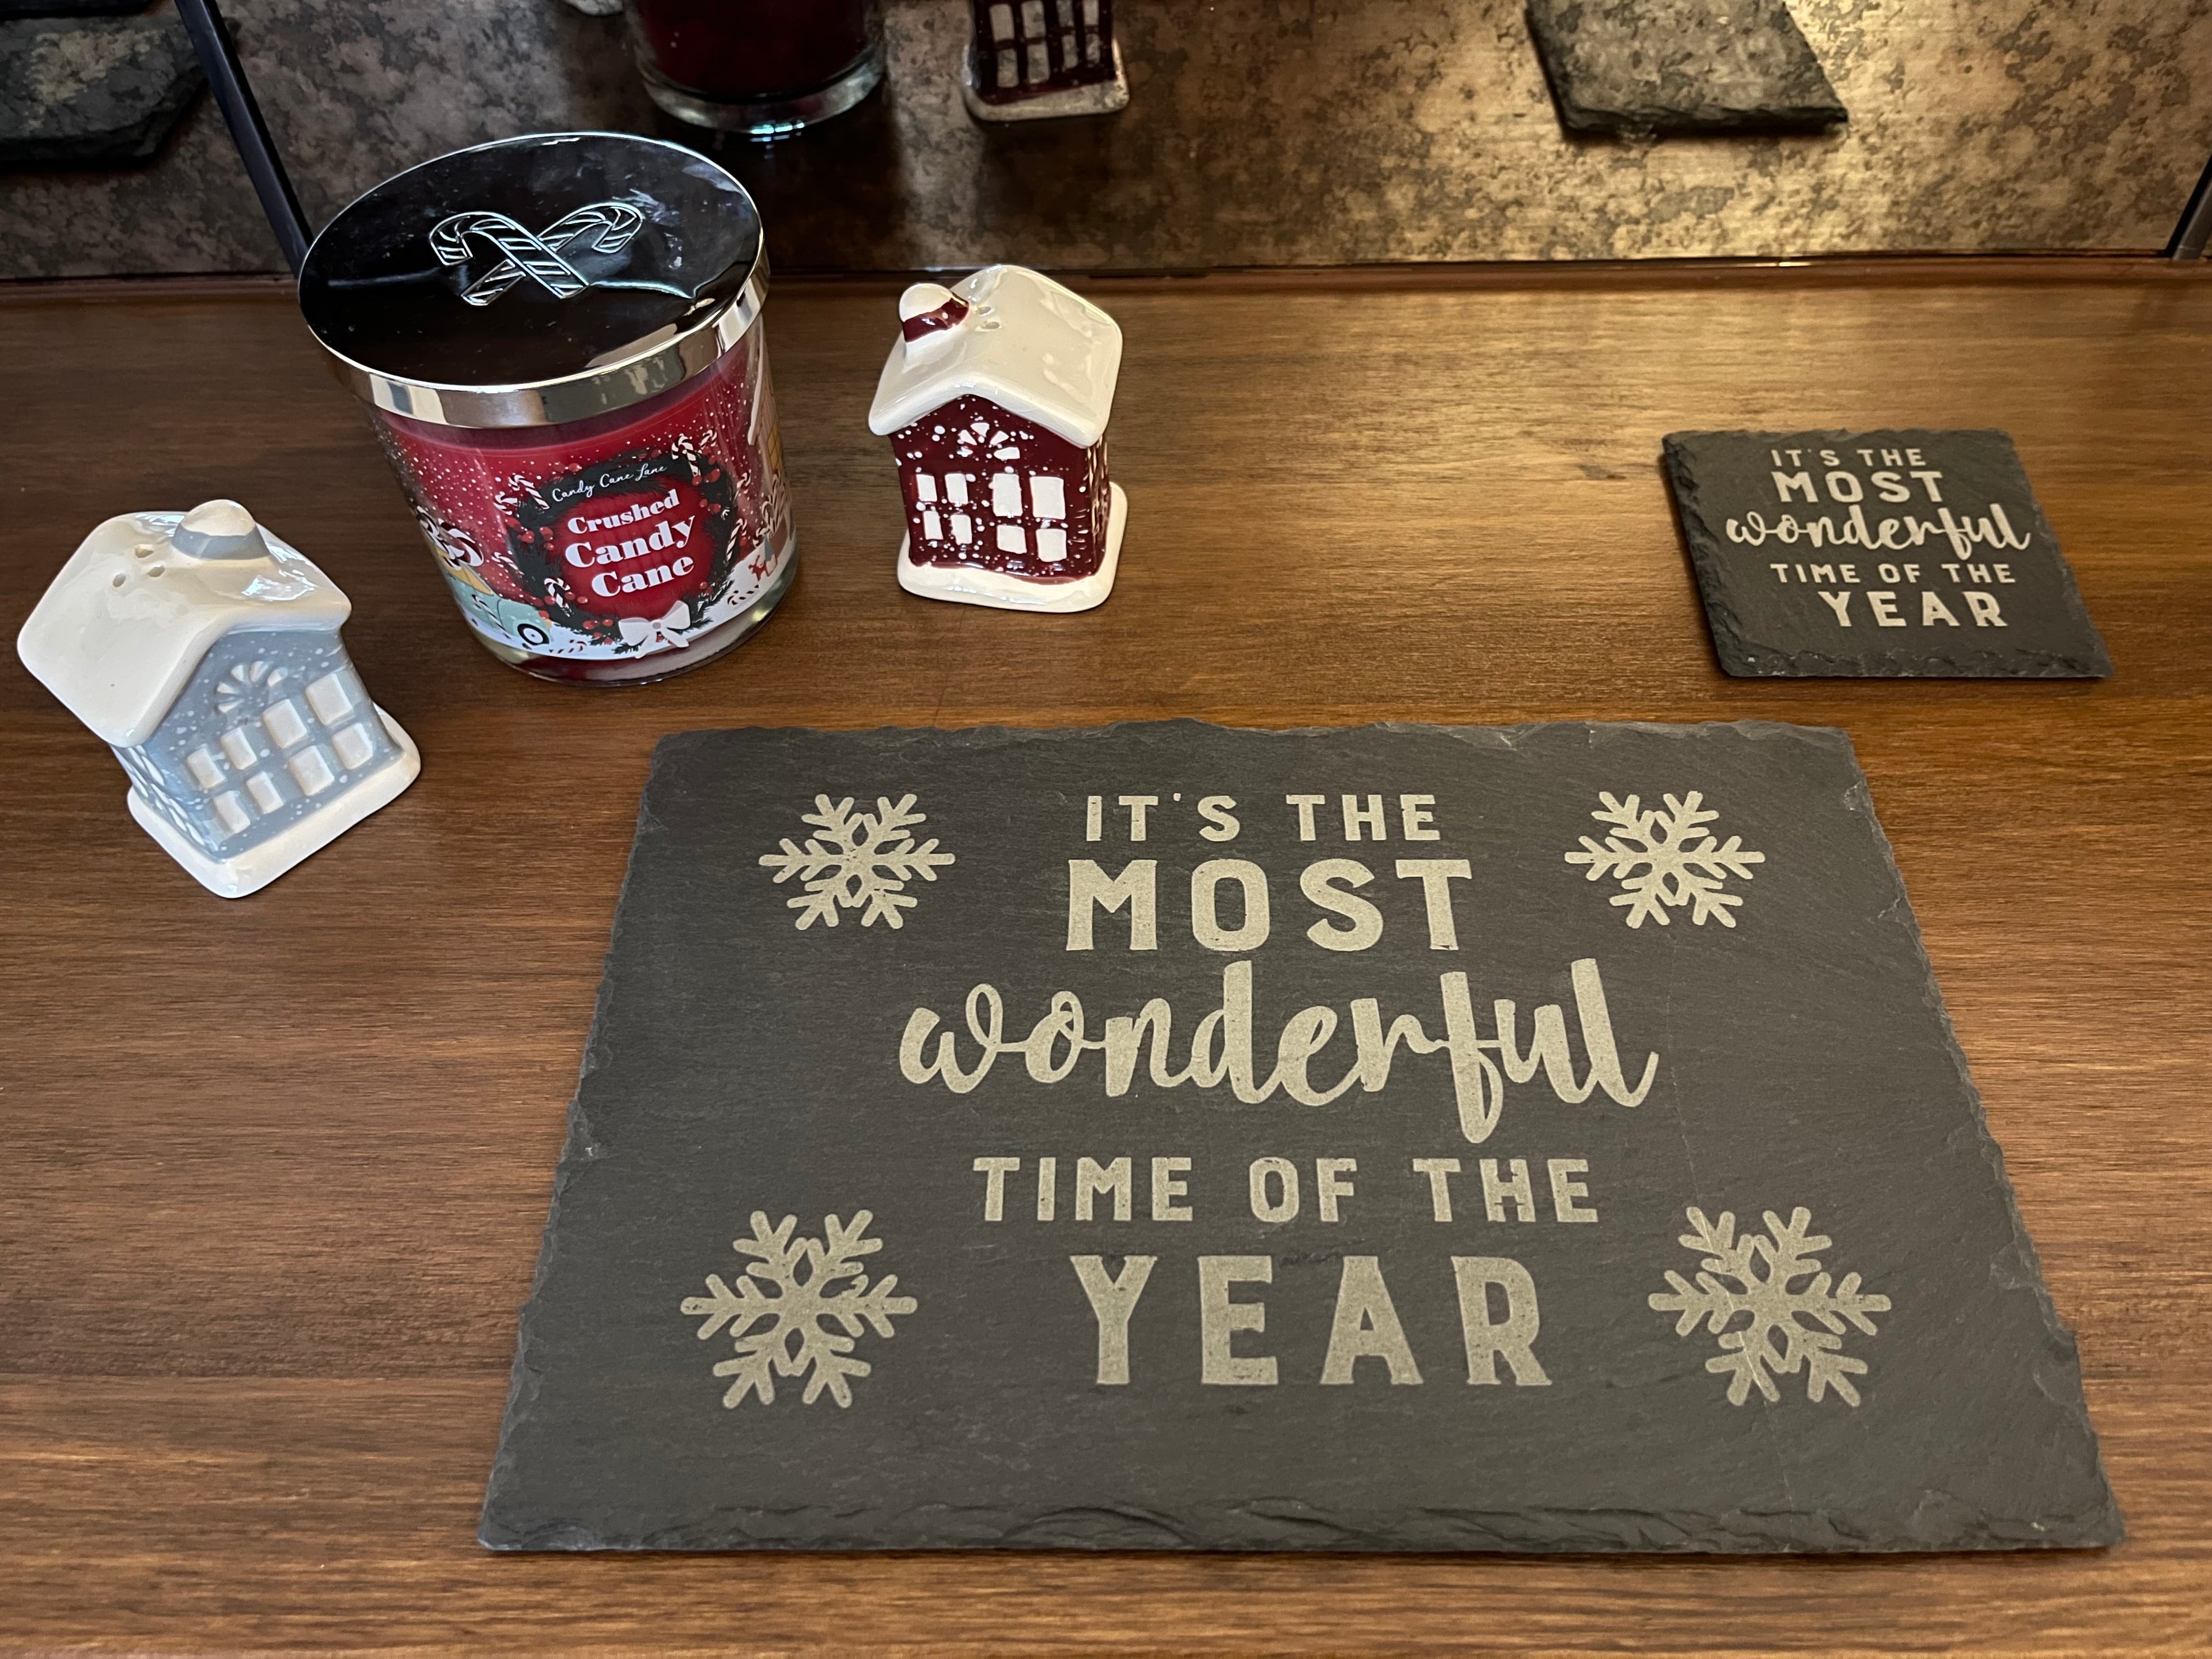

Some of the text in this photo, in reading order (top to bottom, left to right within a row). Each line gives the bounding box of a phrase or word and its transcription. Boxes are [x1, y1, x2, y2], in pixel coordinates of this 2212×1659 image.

[1771, 449, 1926, 467] IT'S THE
[552, 463, 668, 502] Candy Cane Lane
[1771, 471, 1942, 502] MOST
[567, 488, 680, 534] Crushed
[1726, 504, 2031, 560] wonderful
[565, 516, 695, 567] Candy
[592, 556, 694, 597] Cane
[1770, 564, 2016, 583] TIME OF THE
[1818, 592, 2008, 627] YEAR
[1086, 793, 1441, 842] IT'S THE
[1066, 858, 1472, 952] MOST
[899, 958, 1660, 1144] wonderful
[972, 1156, 1599, 1224] TIME OF THE
[1070, 1255, 1552, 1387] YEAR
